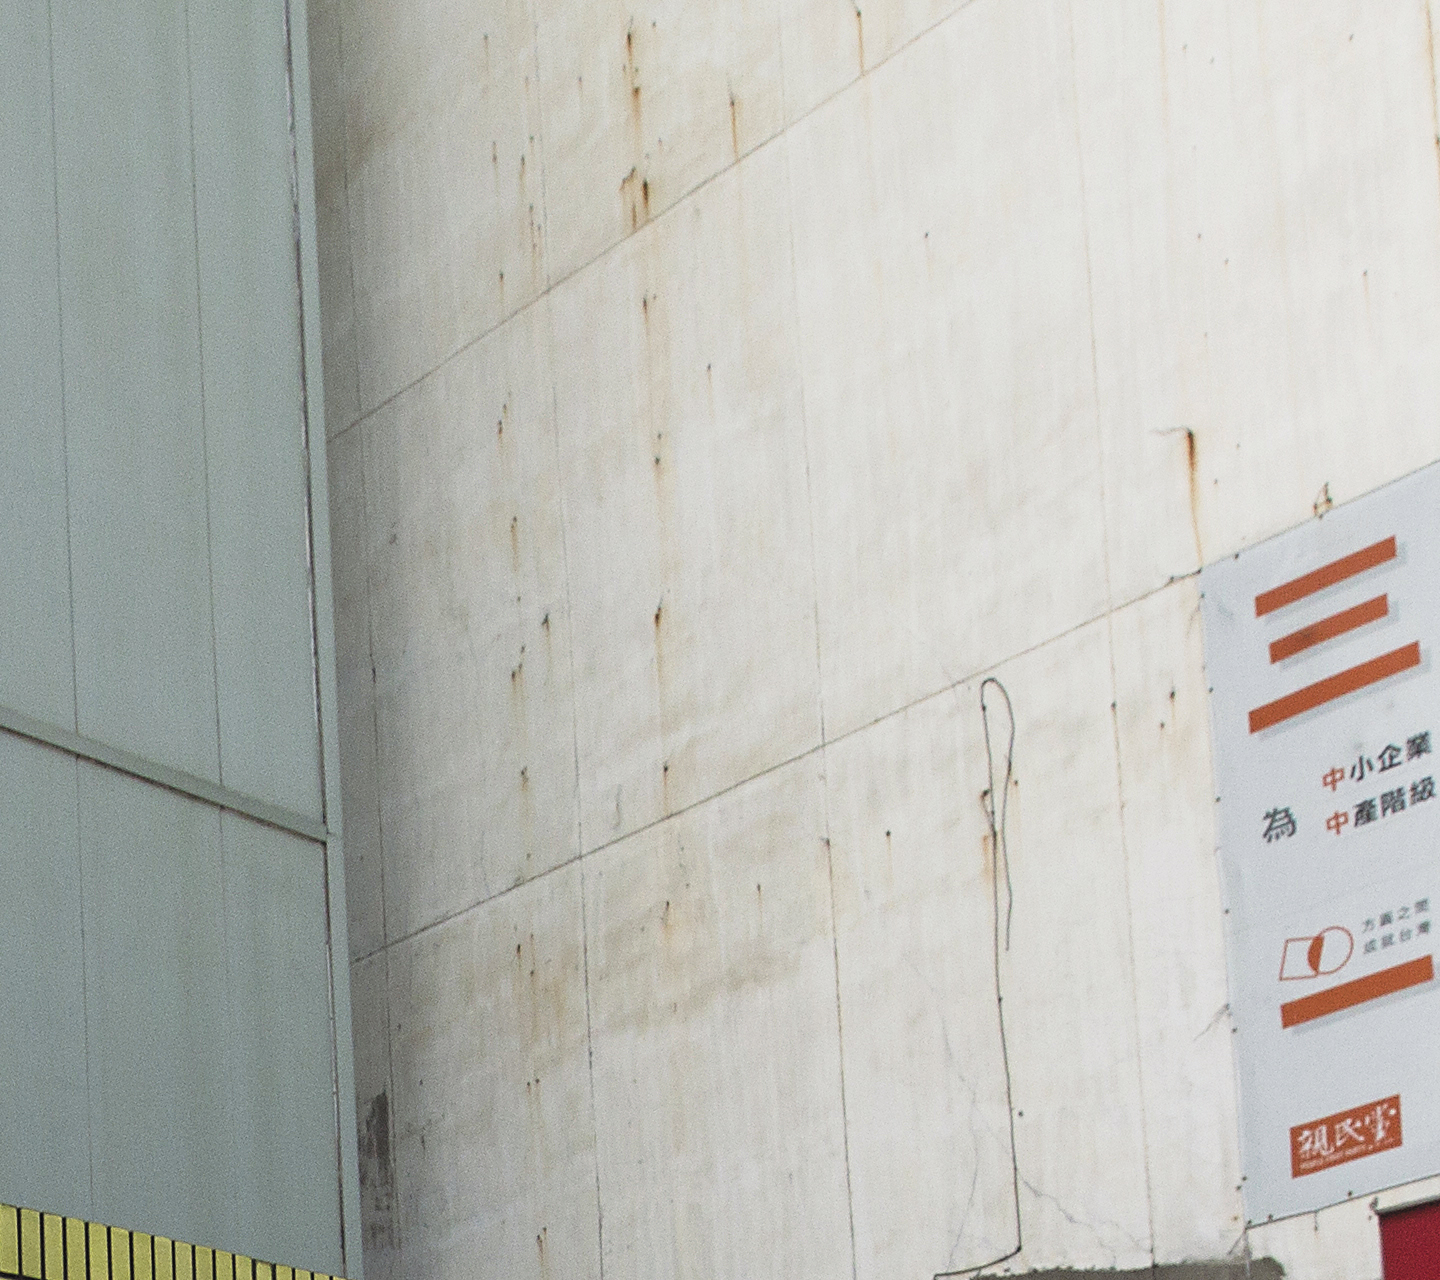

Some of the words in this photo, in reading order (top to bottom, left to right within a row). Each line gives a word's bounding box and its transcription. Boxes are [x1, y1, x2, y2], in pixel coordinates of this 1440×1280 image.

[1322, 731, 1432, 792] 中小企業
[1262, 807, 1297, 842] 為
[1325, 776, 1437, 835] 中產階級
